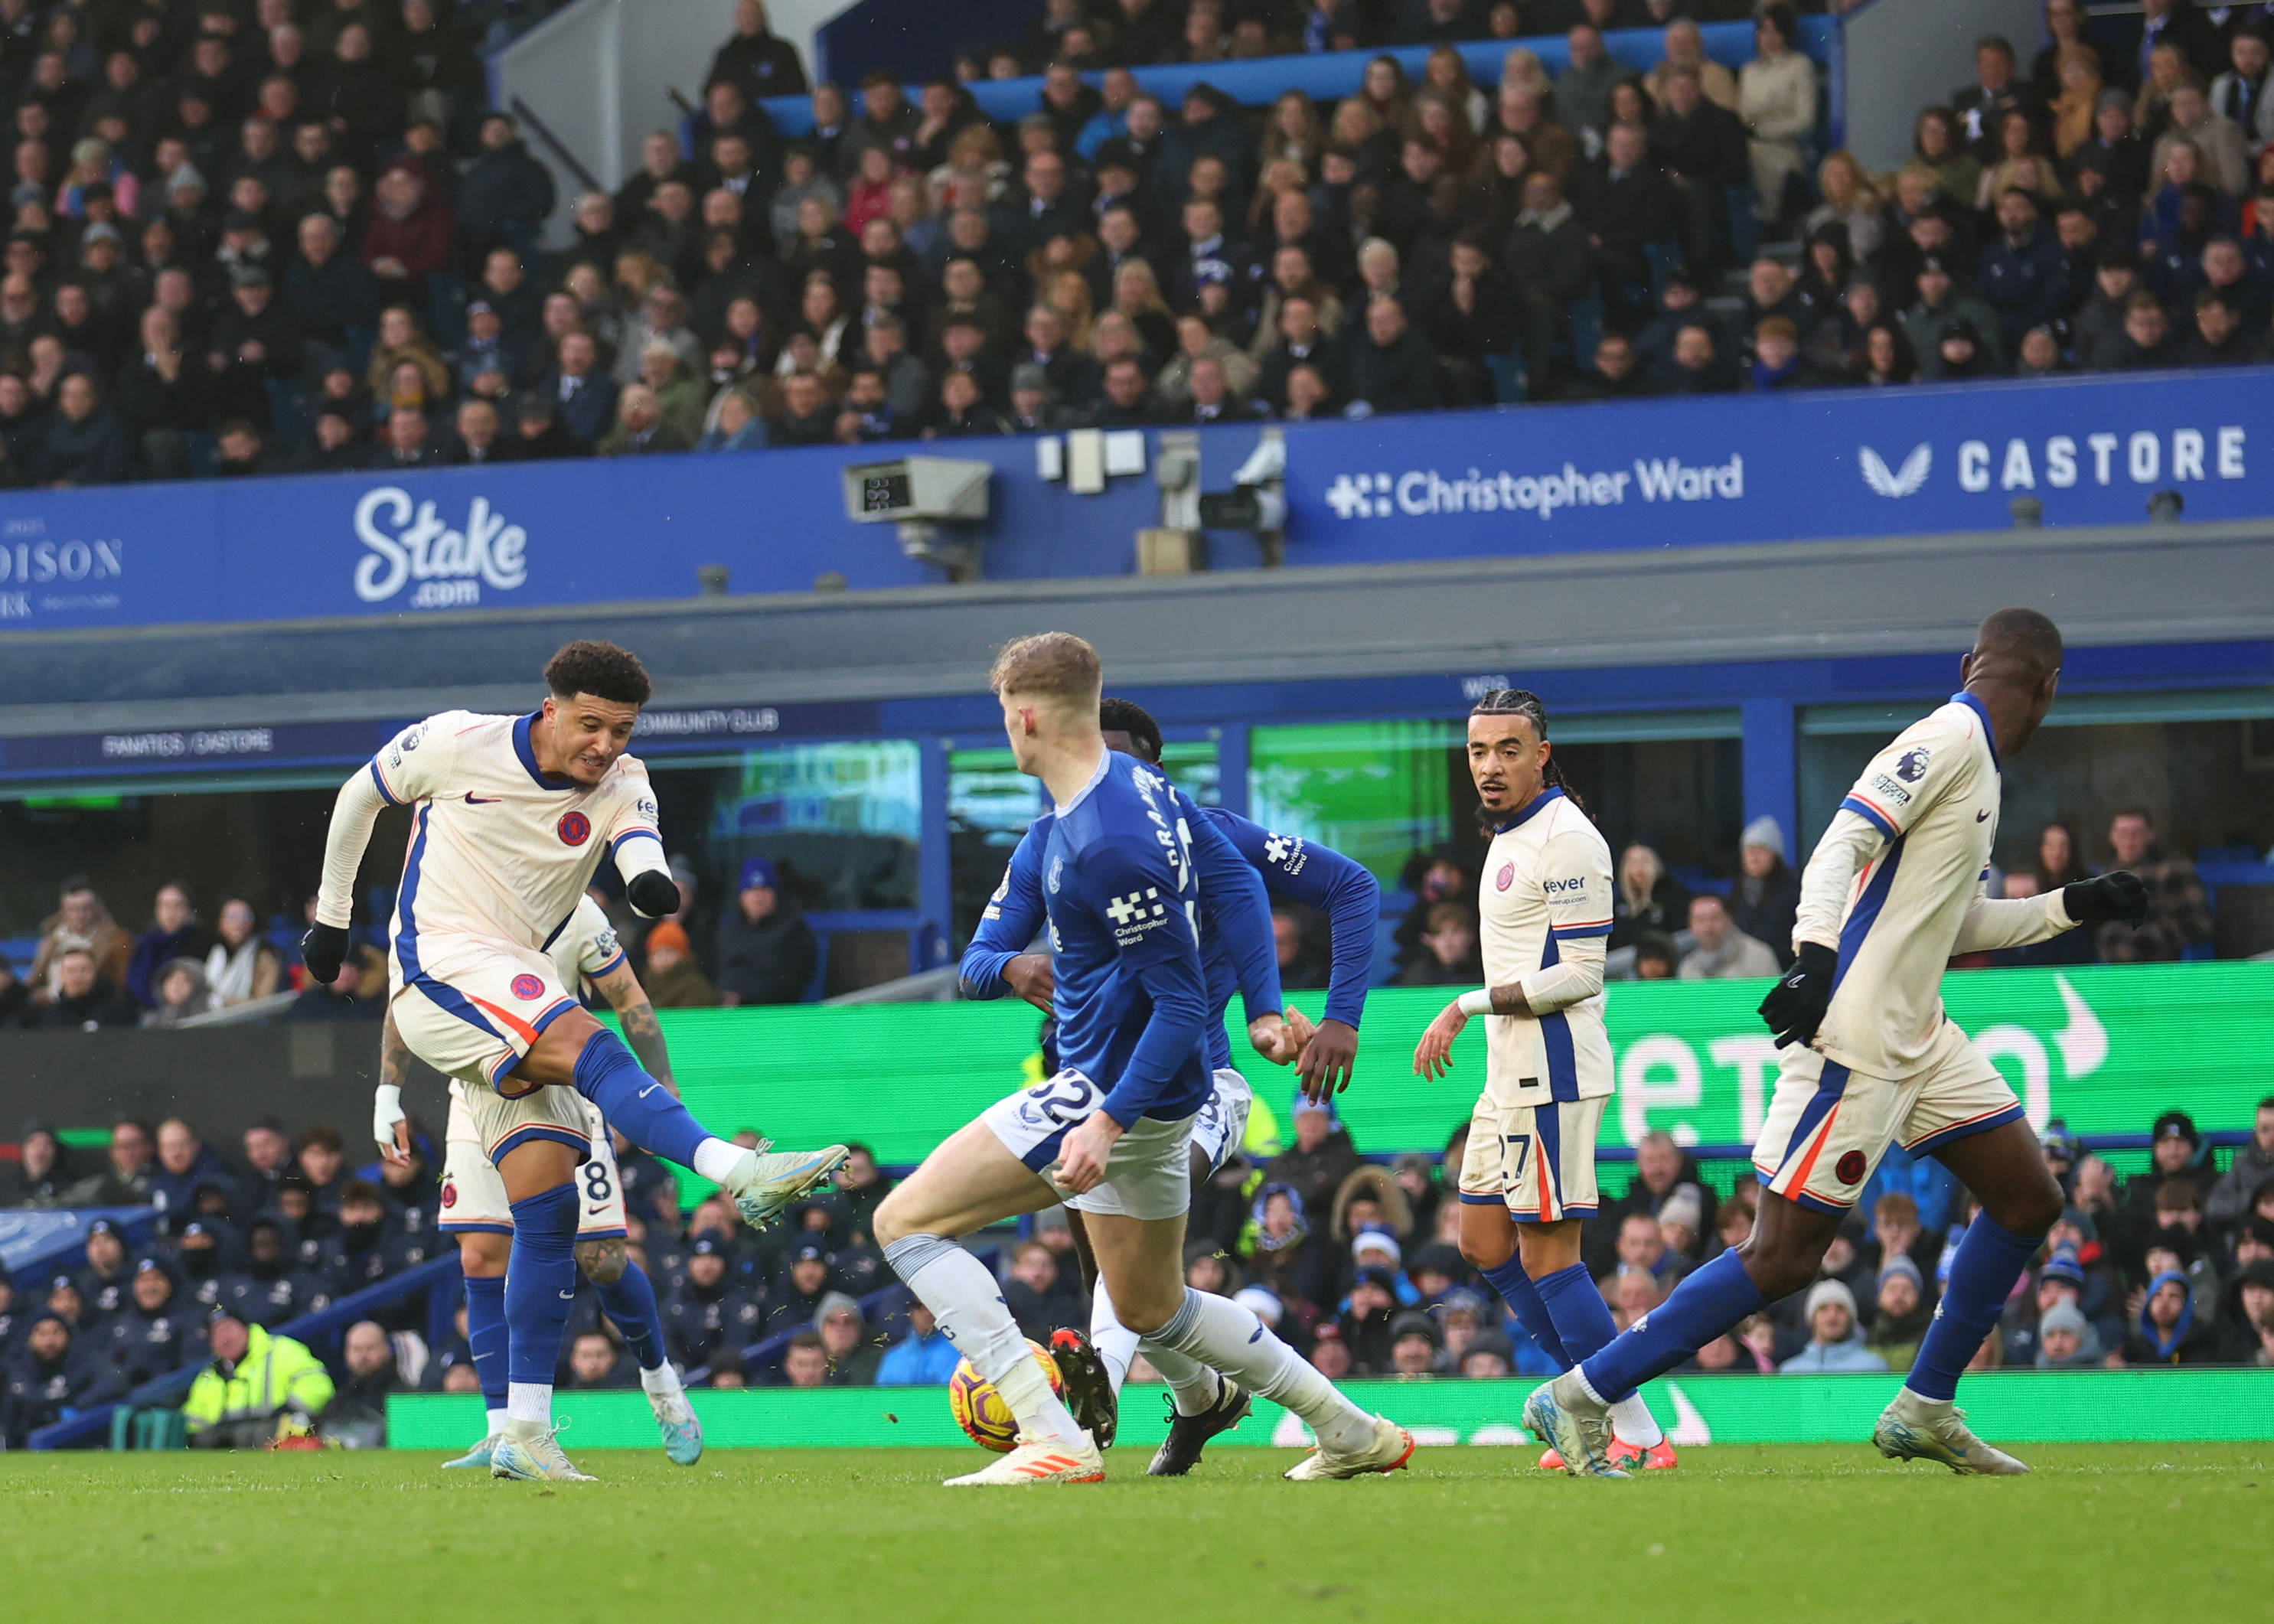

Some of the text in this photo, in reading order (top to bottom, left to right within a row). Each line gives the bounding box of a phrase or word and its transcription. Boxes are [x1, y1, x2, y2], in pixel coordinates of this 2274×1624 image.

[1957, 426, 2246, 493] CASTORE
[1396, 452, 1744, 521] Christopher Ward
[354, 486, 528, 602] Stake
[410, 579, 481, 608] .com
[1290, 853, 1308, 876] Ward
[1542, 876, 1585, 894] fever
[1114, 918, 1169, 938] Christopher
[1117, 933, 1144, 947] Ward
[585, 1161, 612, 1201] 8
